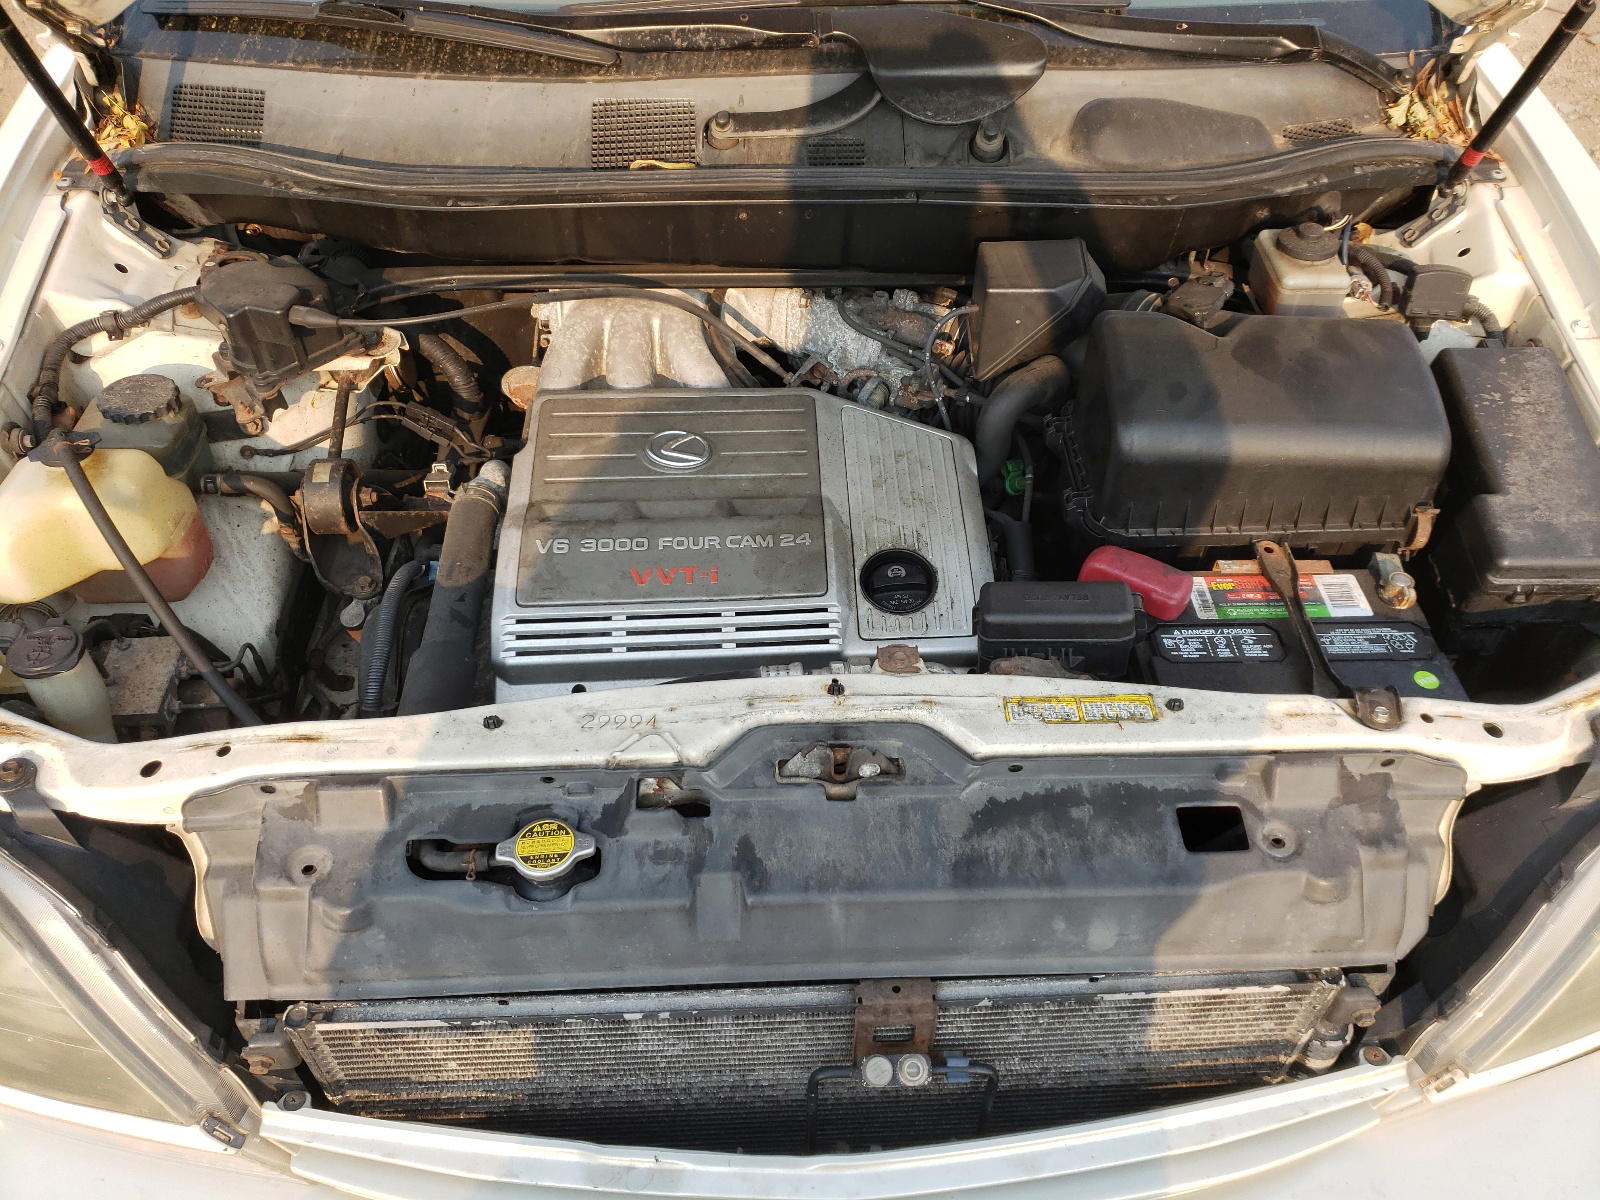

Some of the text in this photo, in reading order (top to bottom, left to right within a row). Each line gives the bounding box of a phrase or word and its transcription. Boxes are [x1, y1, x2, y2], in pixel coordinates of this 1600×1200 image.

[536, 532, 812, 554] V6 3000 FOUR CAM 24
[629, 564, 719, 586] VVT-i
[525, 829, 566, 838] CAUTION
